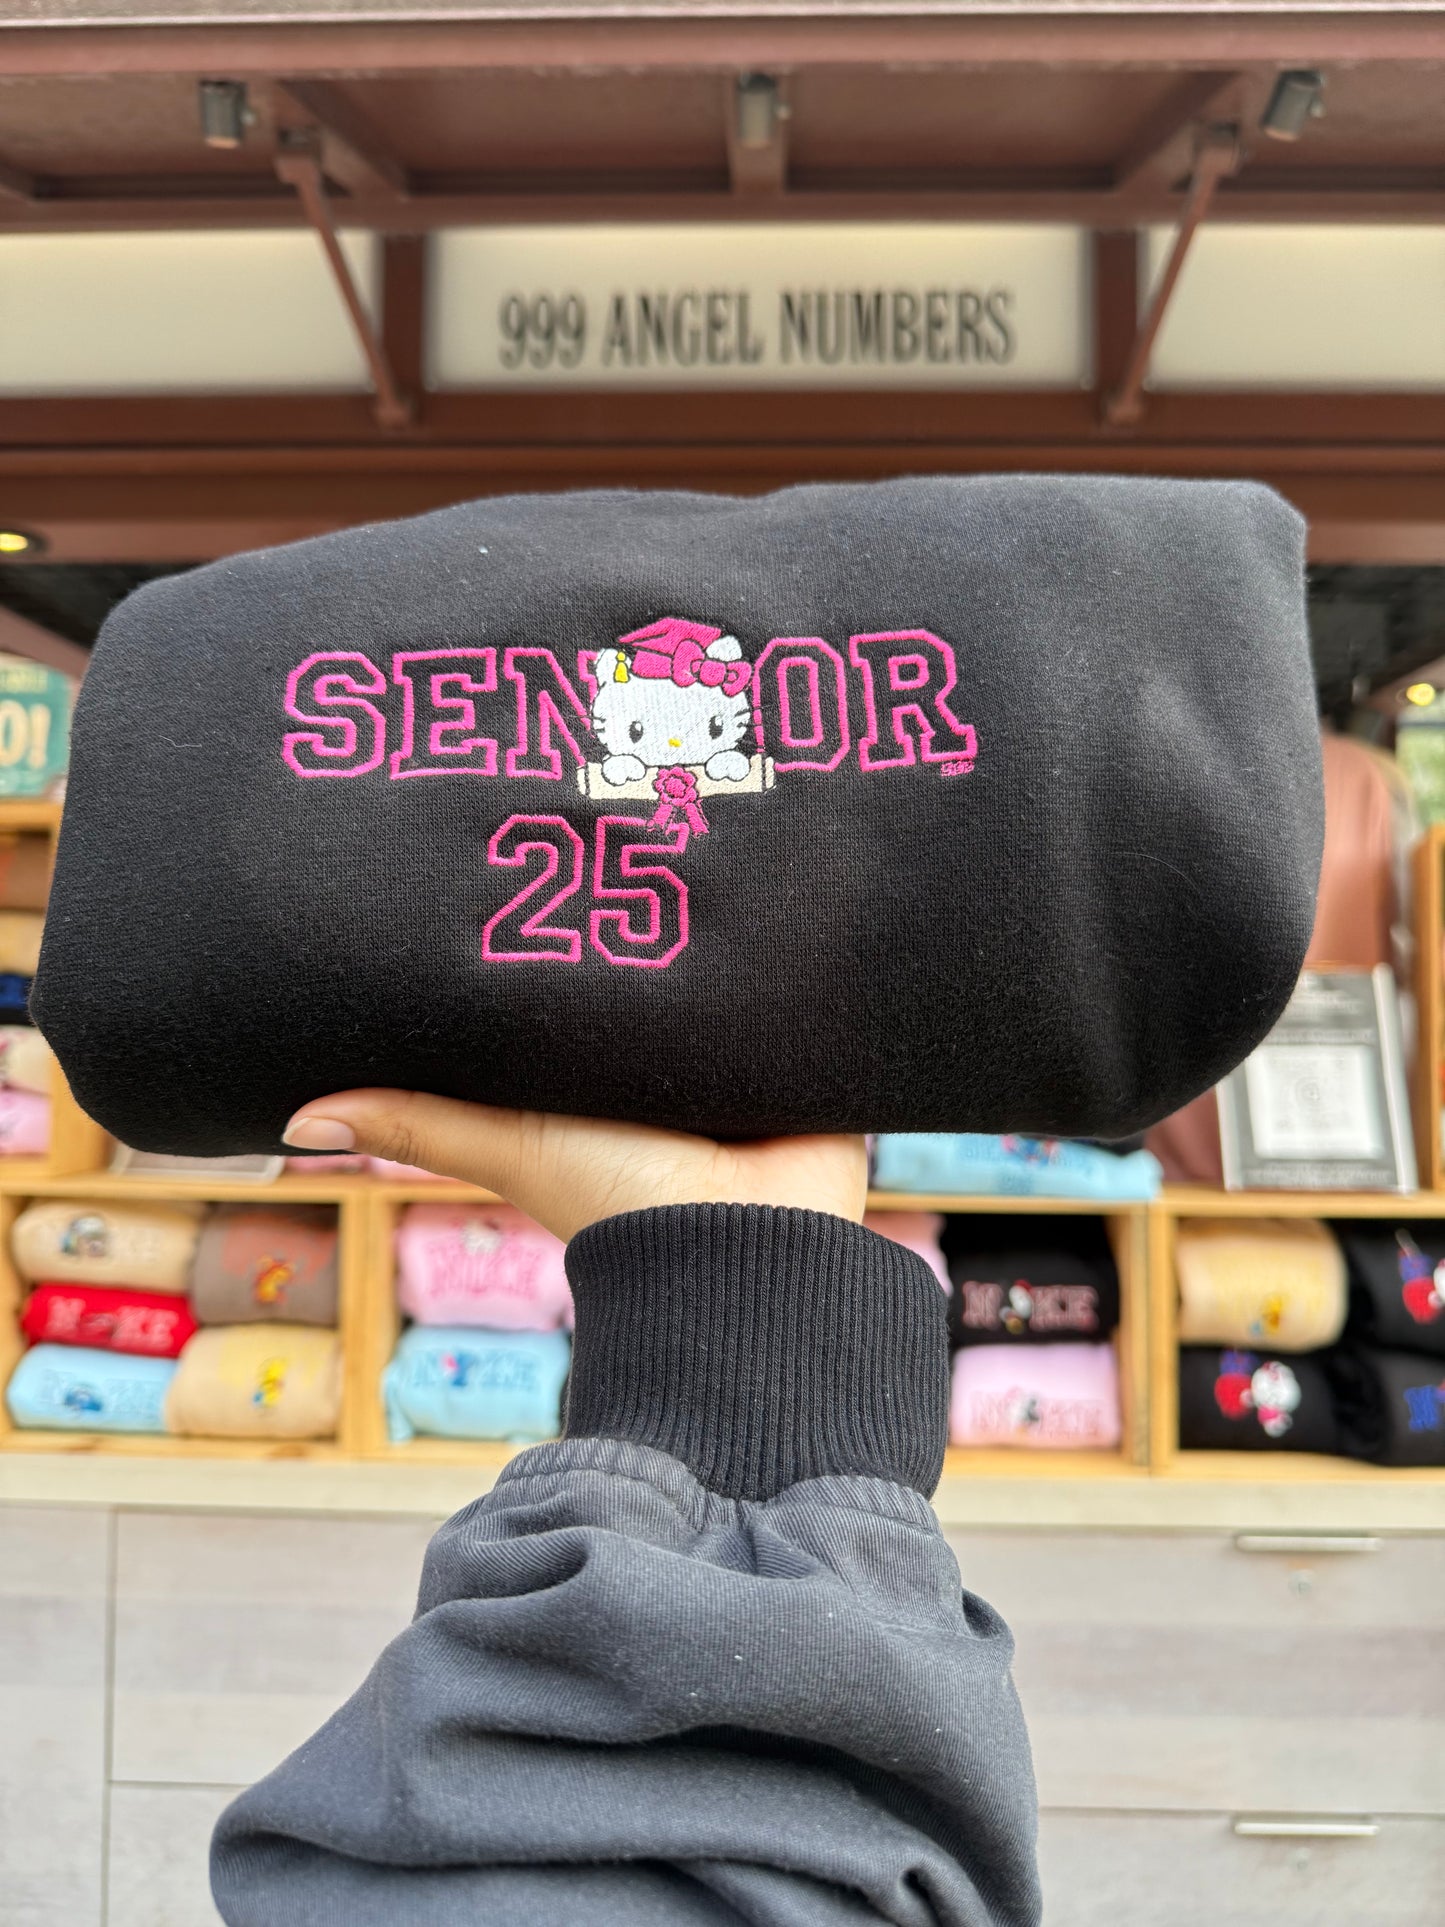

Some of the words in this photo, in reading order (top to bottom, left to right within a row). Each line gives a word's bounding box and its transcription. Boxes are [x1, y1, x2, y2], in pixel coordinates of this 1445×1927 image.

[497, 292, 587, 370] 999
[602, 289, 766, 367] ANGEL
[779, 289, 1018, 367] NUMBERS
[282, 628, 979, 781] SENOR
[482, 814, 689, 968] 25
[45, 1295, 180, 1351] NKE
[962, 1280, 1100, 1333] NKE
